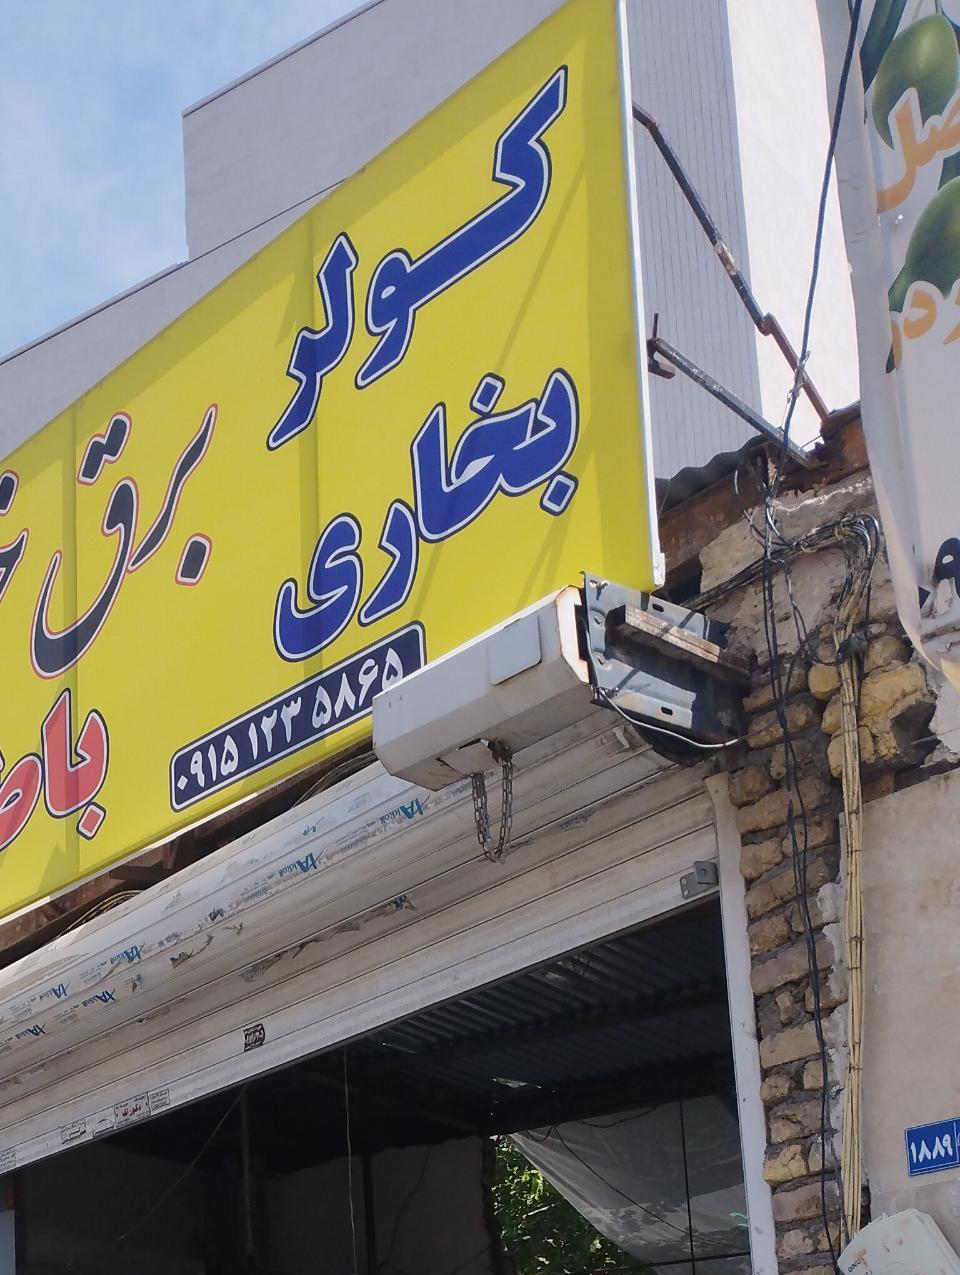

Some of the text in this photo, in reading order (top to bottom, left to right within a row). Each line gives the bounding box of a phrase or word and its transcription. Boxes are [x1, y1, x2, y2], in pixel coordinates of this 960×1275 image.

[266, 64, 568, 452] کولر
[30, 403, 219, 680] برق
[274, 368, 580, 662] بخاری
[177, 647, 404, 791] ۰۹۱۵ ۱۲۳ ۵۸۶۵
[910, 1133, 953, 1164] ۱۸۸۹
